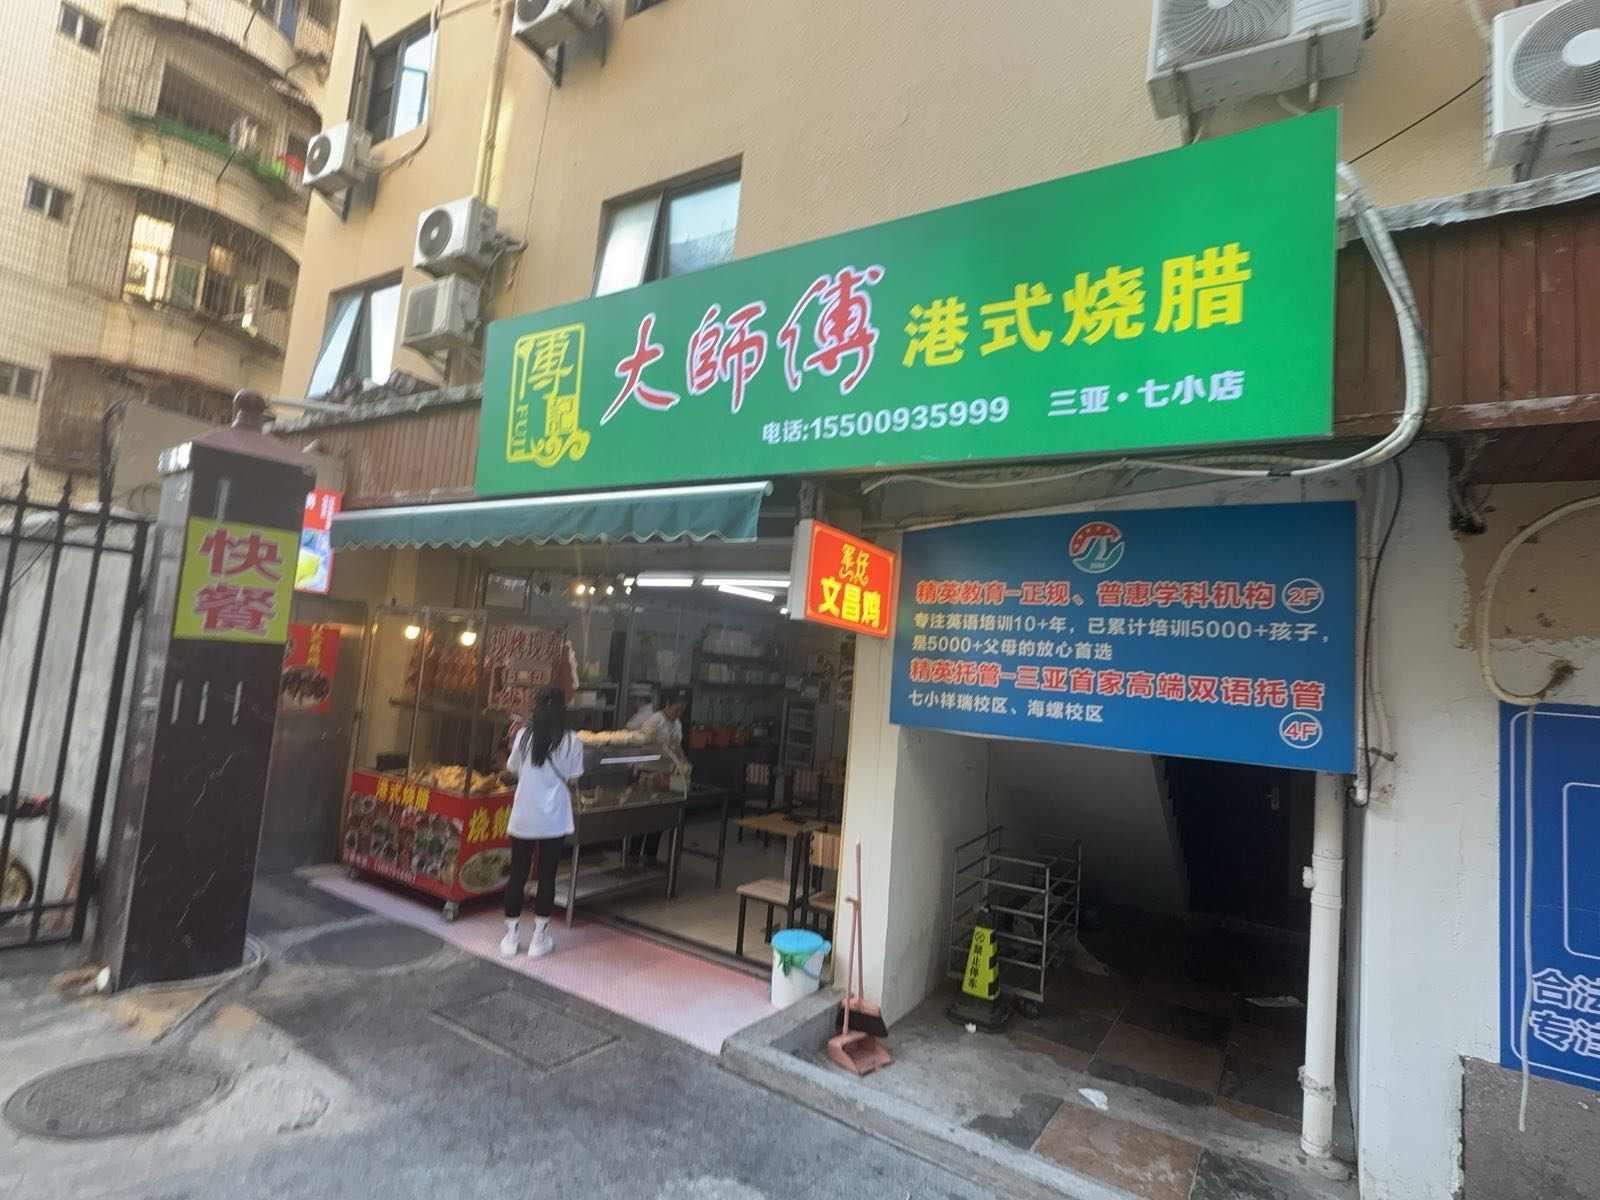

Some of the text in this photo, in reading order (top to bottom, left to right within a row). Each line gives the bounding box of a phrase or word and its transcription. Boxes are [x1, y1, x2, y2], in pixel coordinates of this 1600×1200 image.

[902, 242, 1252, 368] 港式烧腊
[1047, 369, 1245, 417] 三亚·七小店
[193, 527, 284, 637] 快餐
[818, 576, 881, 628] 文昌鸡
[1286, 588, 1321, 605] 2F
[912, 634, 1113, 661] 是5000+父母的放心首选
[1284, 721, 1318, 741] 4F
